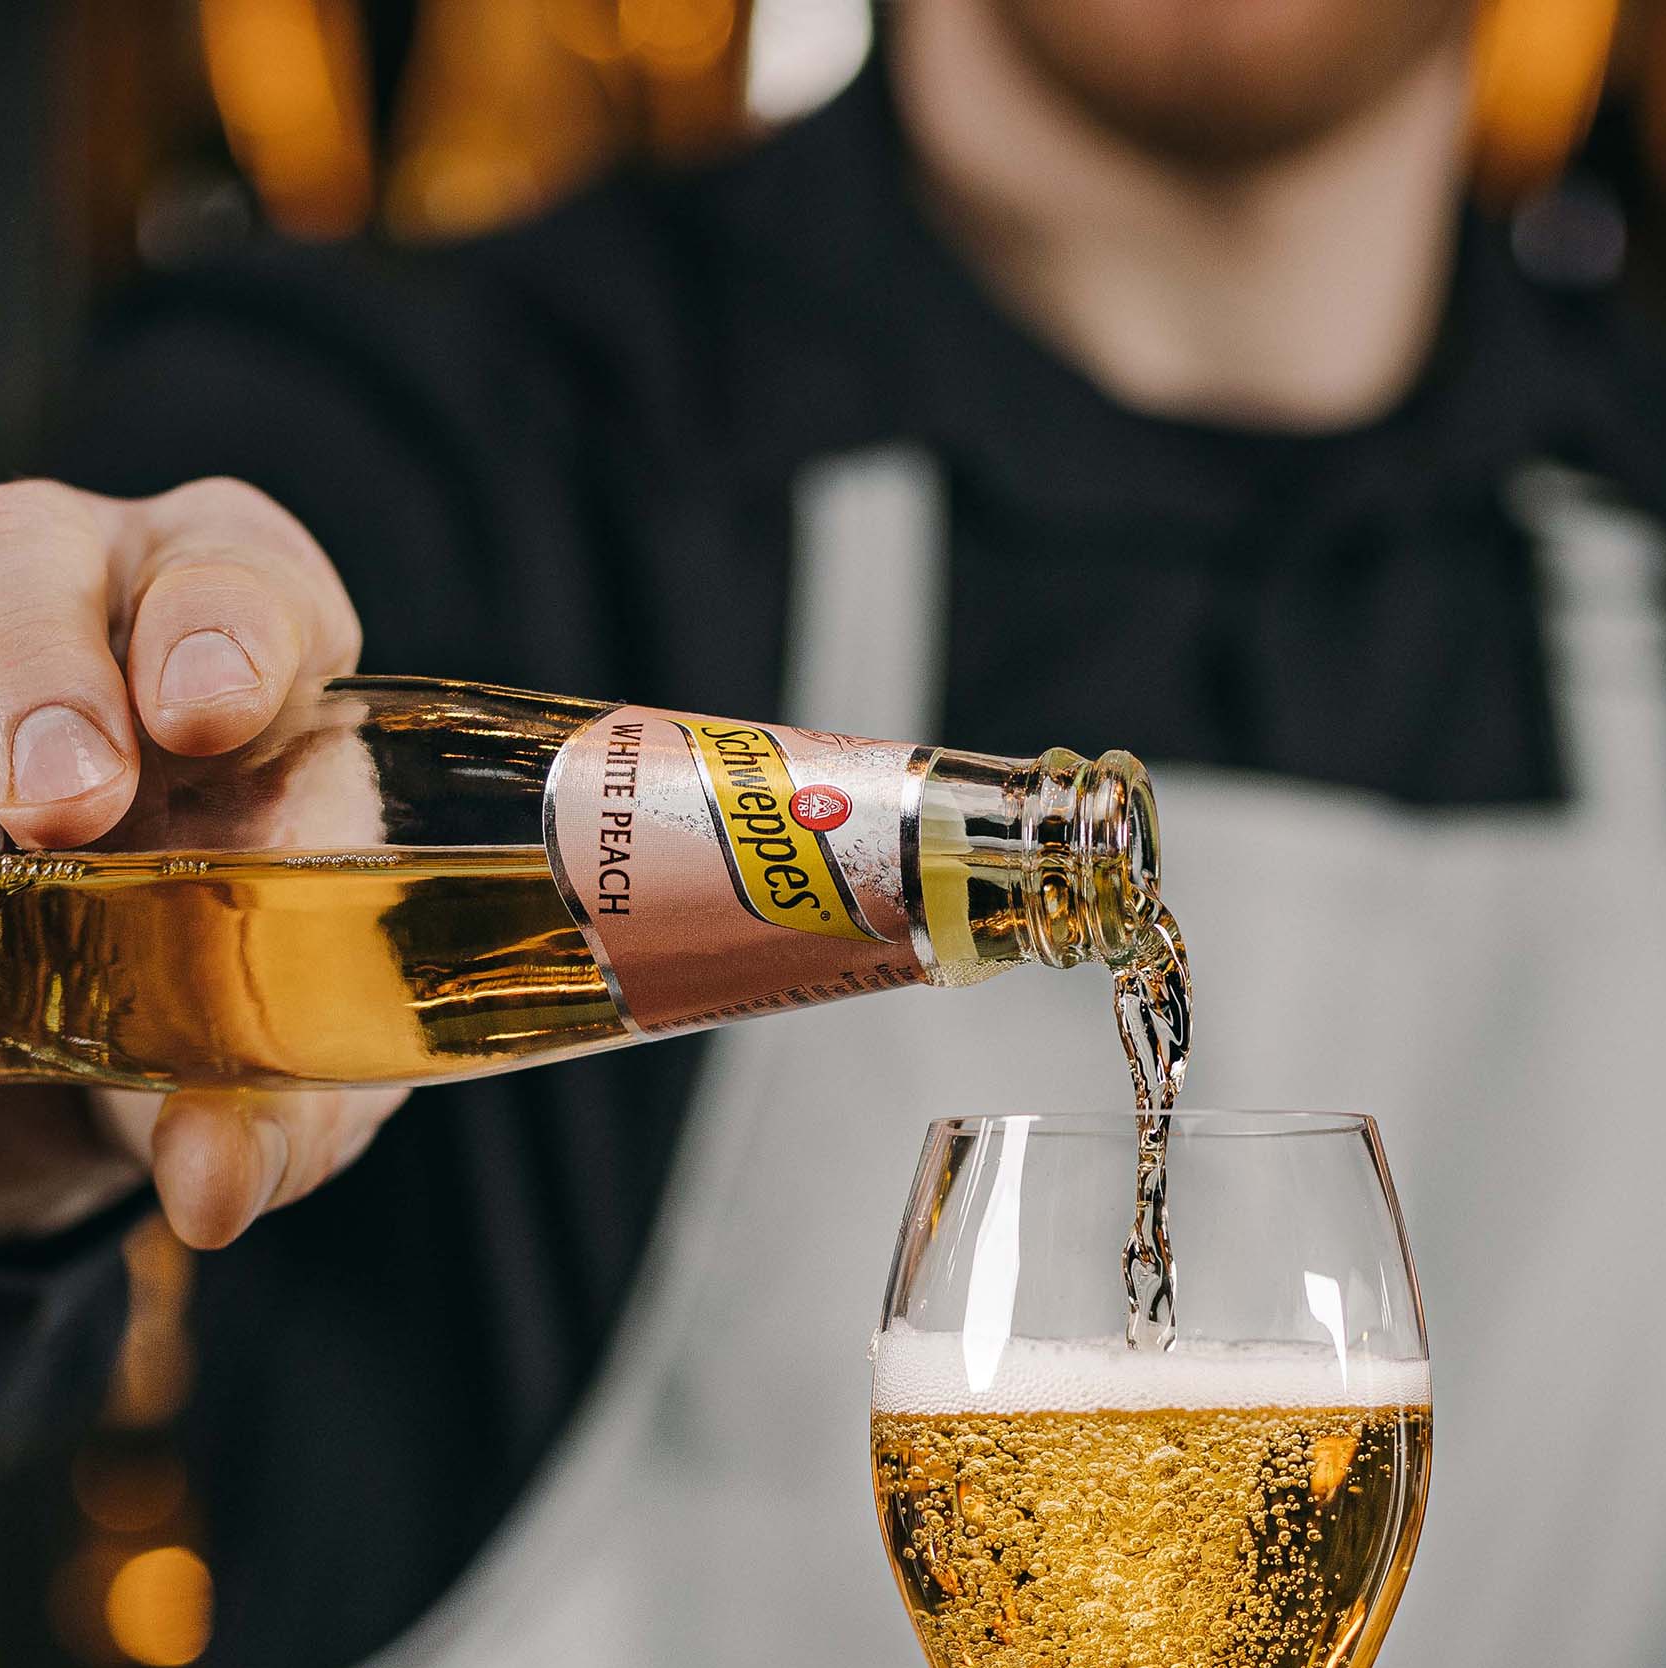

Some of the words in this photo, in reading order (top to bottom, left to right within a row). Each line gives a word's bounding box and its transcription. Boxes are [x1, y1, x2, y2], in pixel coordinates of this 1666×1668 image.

[603, 722, 643, 798] WHITE
[797, 794, 810, 817] 1783
[598, 811, 633, 916] PEACH
